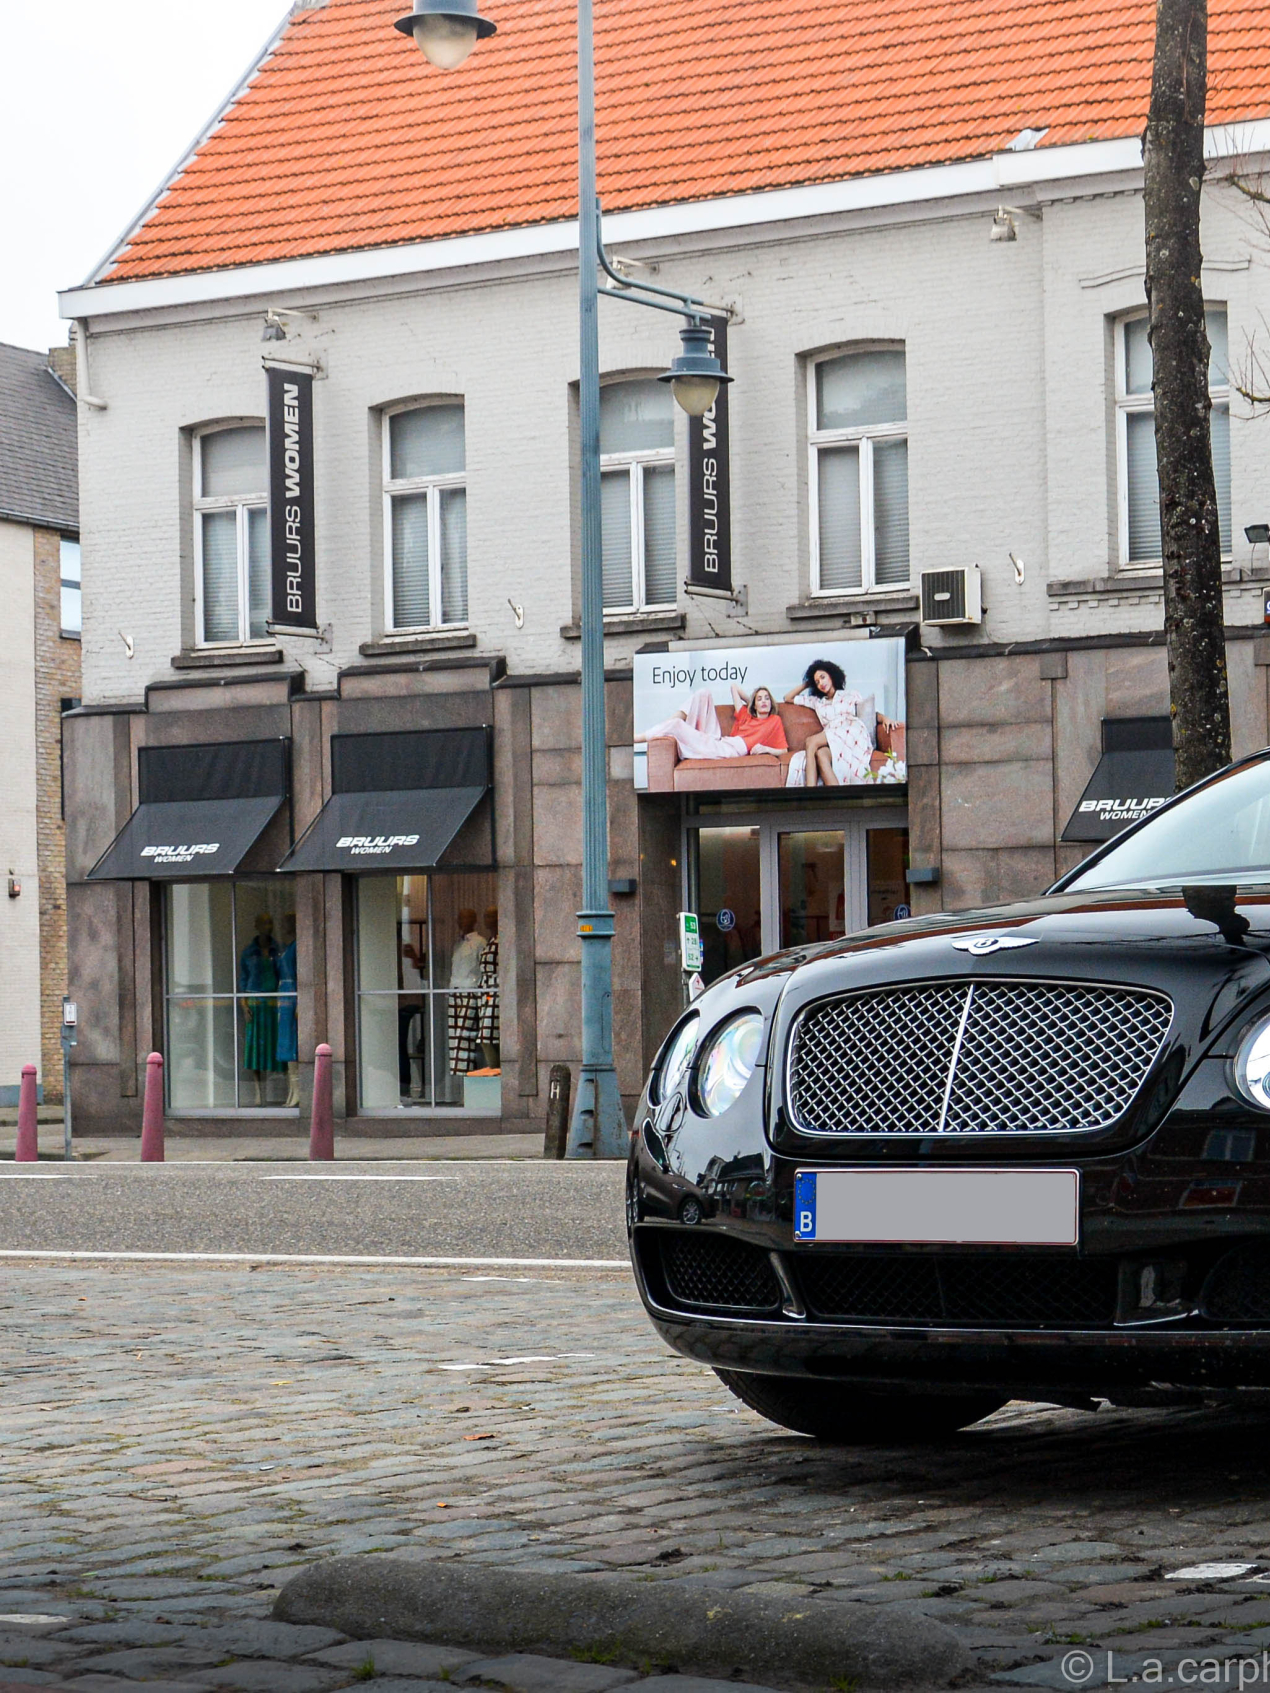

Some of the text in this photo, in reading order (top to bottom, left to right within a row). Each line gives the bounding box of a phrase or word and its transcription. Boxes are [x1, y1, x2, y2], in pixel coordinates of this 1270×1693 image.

[284, 383, 302, 613] BRUURS WOMEN
[703, 457, 718, 573] BRUURS
[652, 661, 748, 688] Enjoy today
[1078, 797, 1173, 812] BRUUR
[336, 835, 420, 848] BRUURS
[140, 843, 220, 857] BRUURS
[350, 846, 393, 855] WOMEN
[154, 854, 194, 863] WOMEN
[800, 1211, 813, 1232] B
